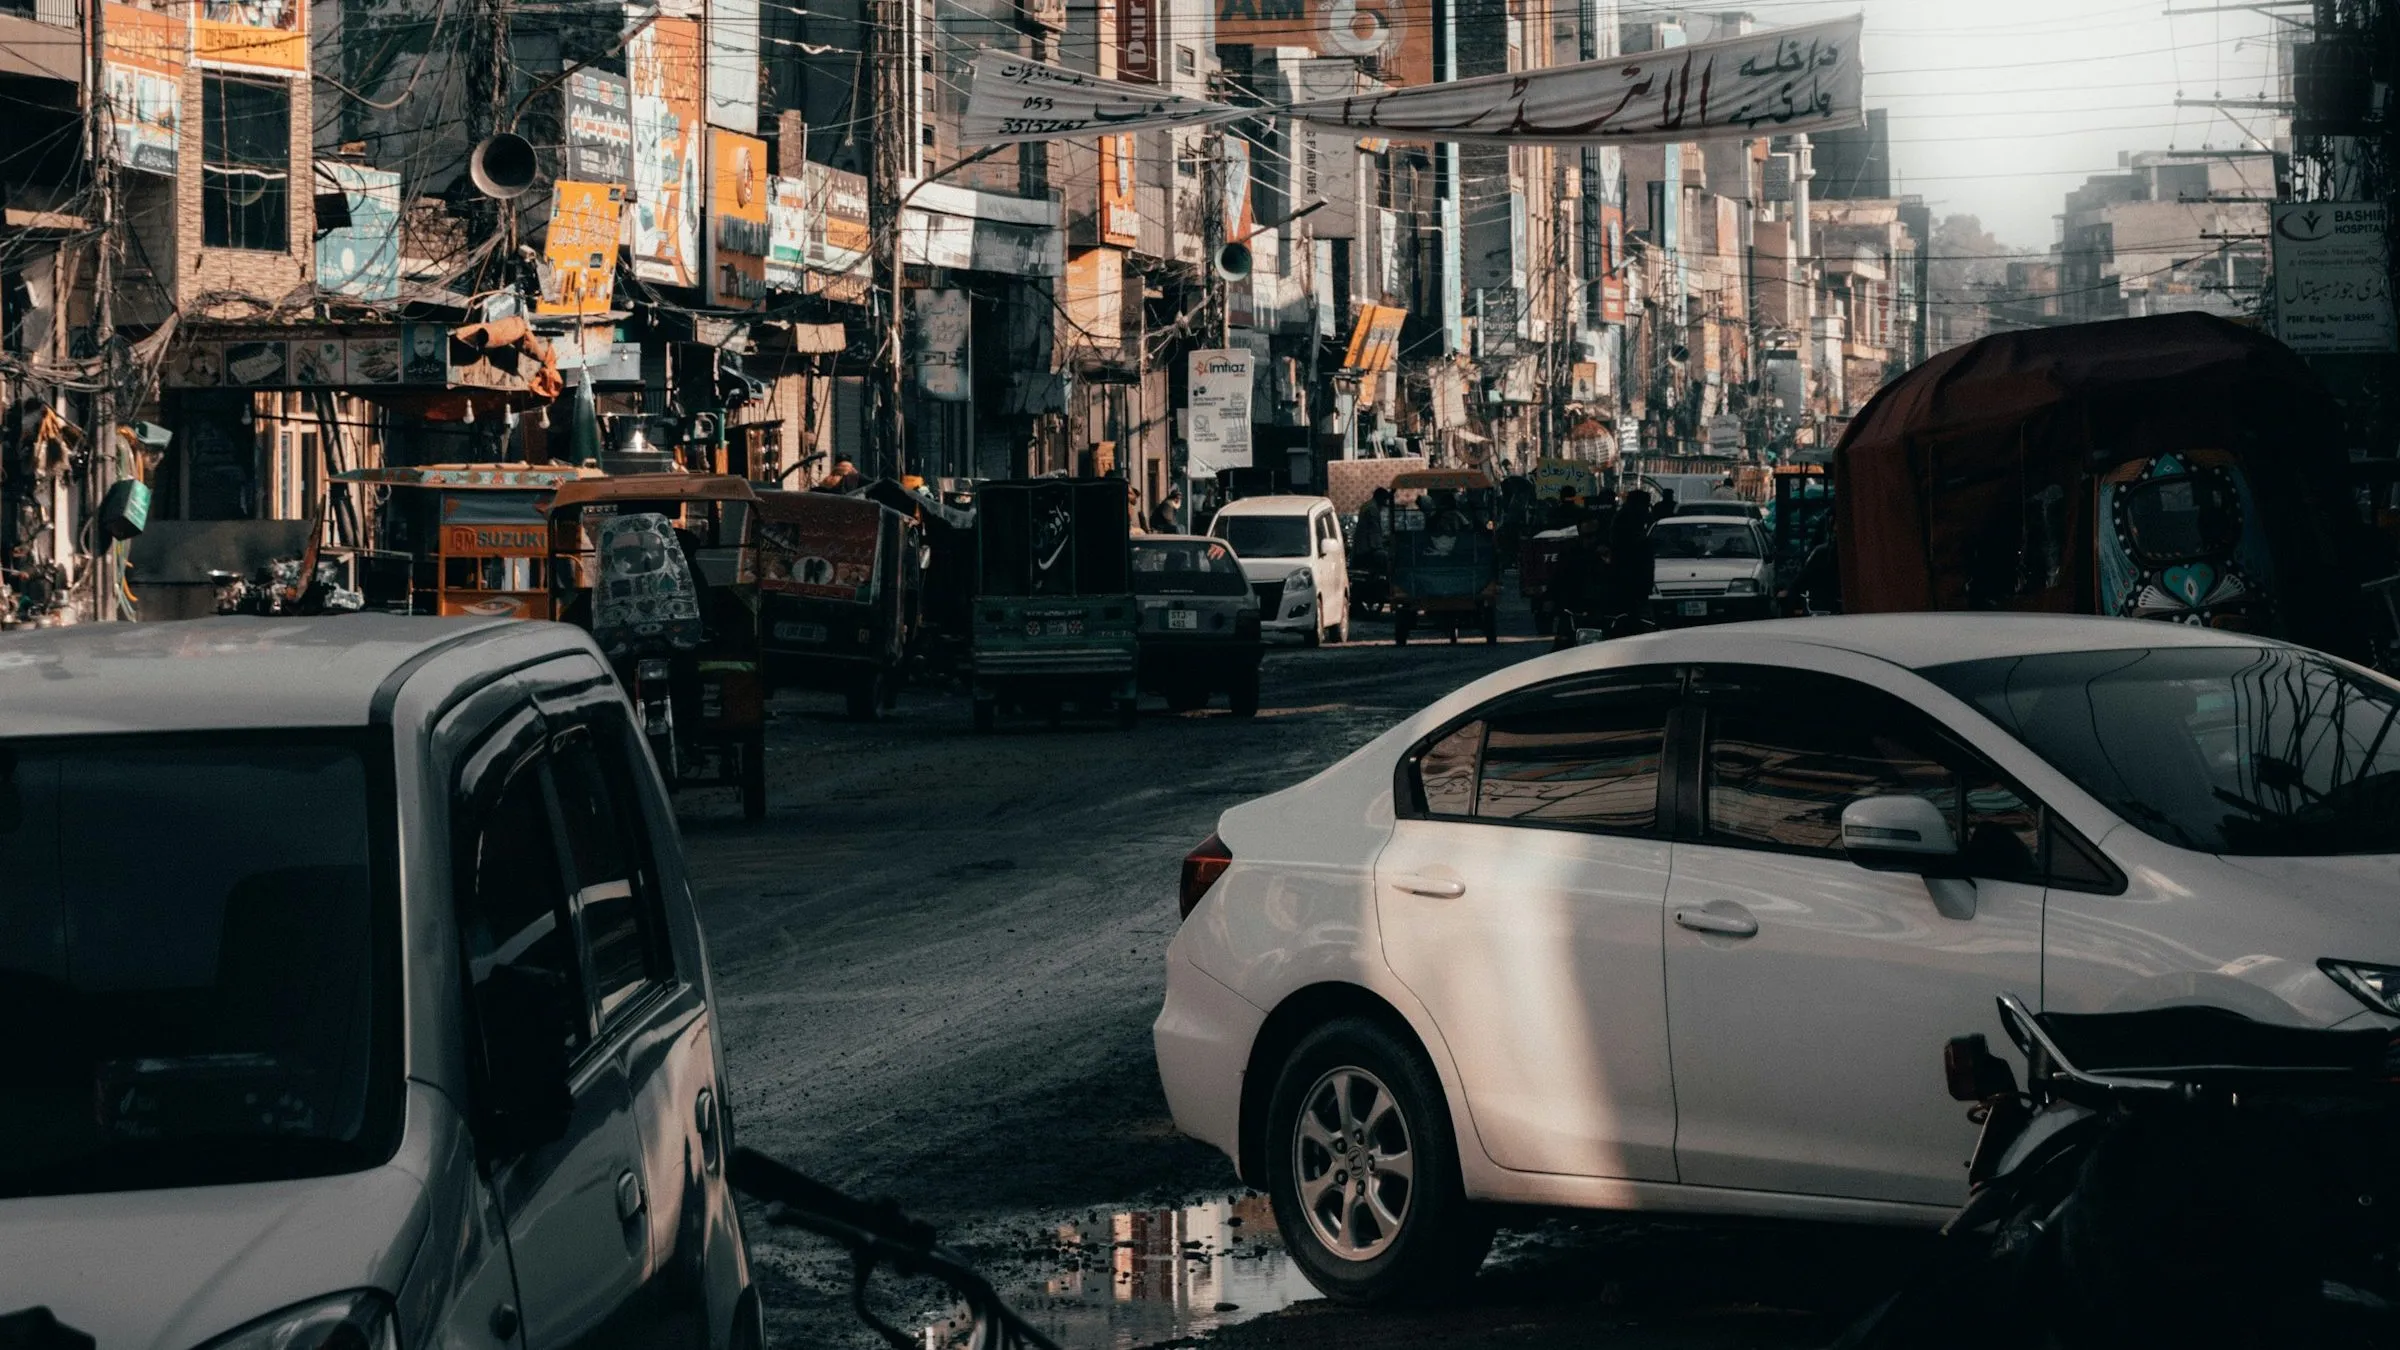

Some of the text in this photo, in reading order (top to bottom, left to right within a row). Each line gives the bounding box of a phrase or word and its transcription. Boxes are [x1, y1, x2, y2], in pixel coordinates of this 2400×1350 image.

[1023, 97, 1053, 111] 053
[2334, 209, 2386, 222] BASHIR
[477, 531, 546, 548] SUZUKI
